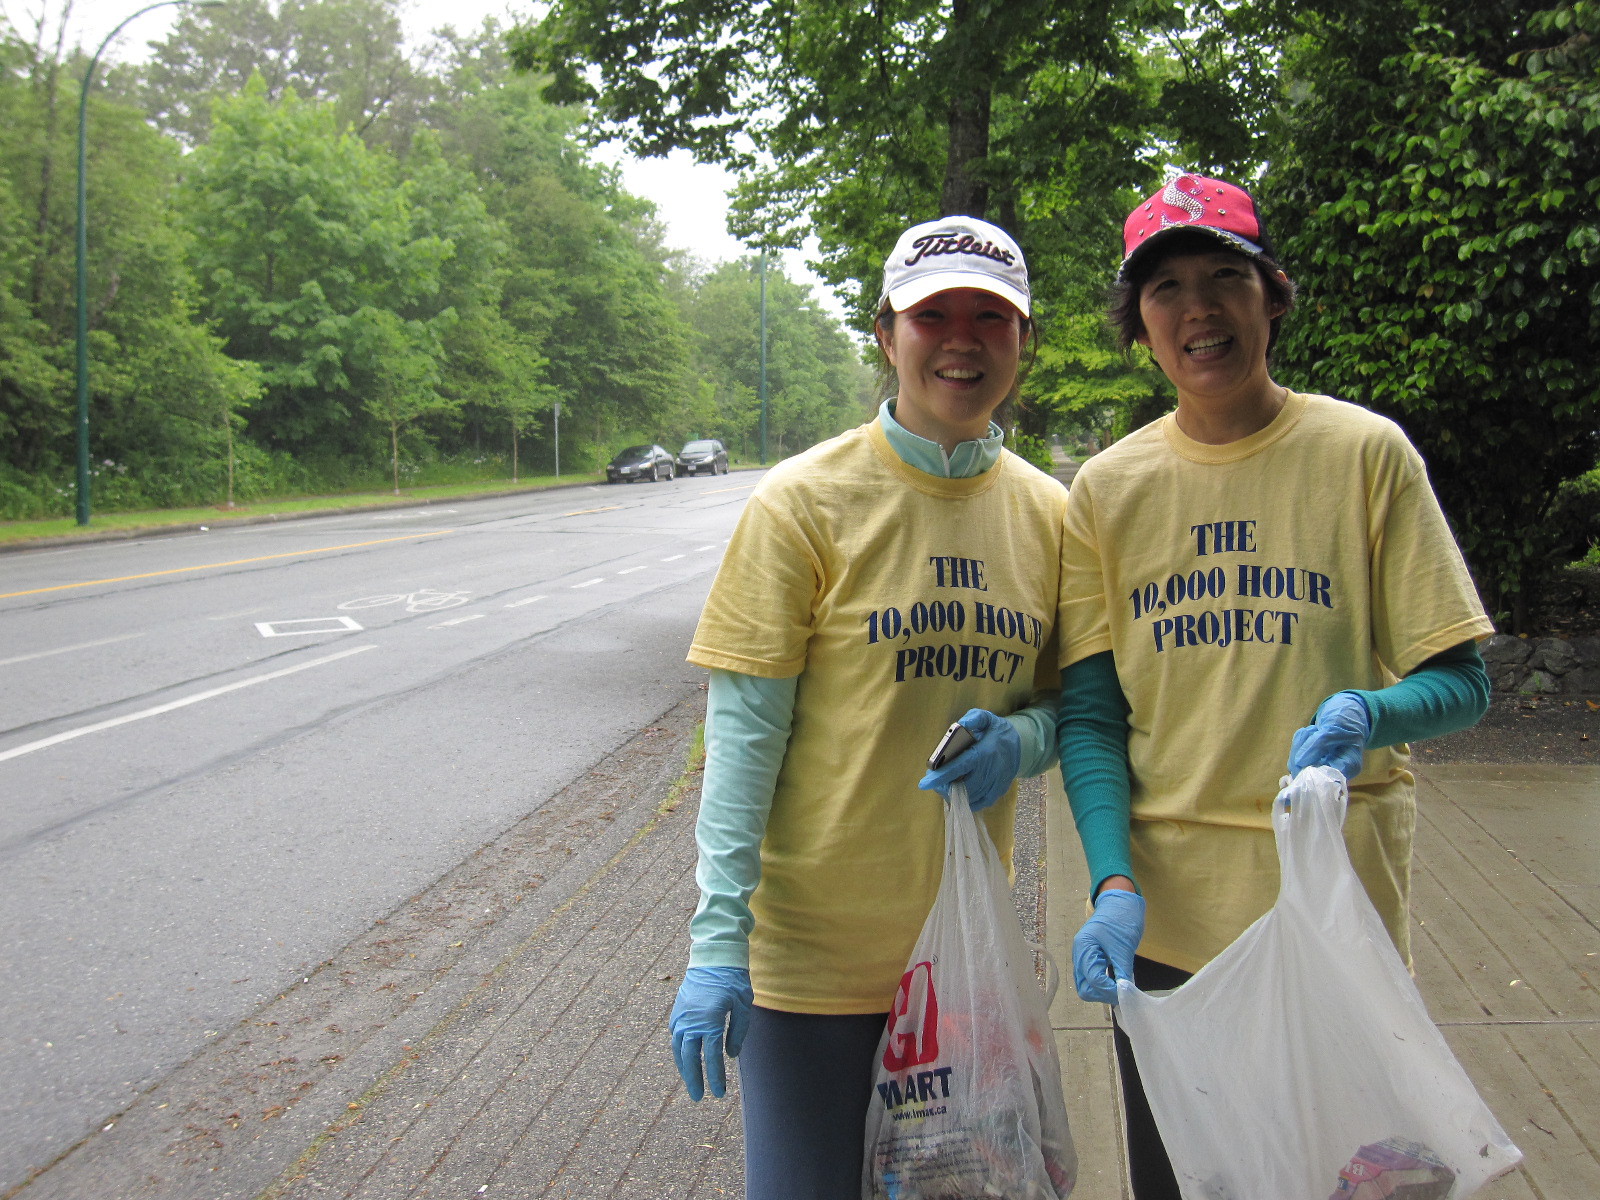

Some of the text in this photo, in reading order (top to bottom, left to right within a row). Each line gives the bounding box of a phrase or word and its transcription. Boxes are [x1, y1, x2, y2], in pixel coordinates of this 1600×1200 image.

[904, 232, 1015, 267] Titleist
[1190, 520, 1257, 557] THE
[930, 556, 988, 592] THE
[1128, 564, 1334, 621] 10,000 HOUR
[864, 600, 1043, 650] 10,000 HOUR
[1152, 608, 1299, 654] PROJECT
[894, 643, 1025, 684] PROJECT
